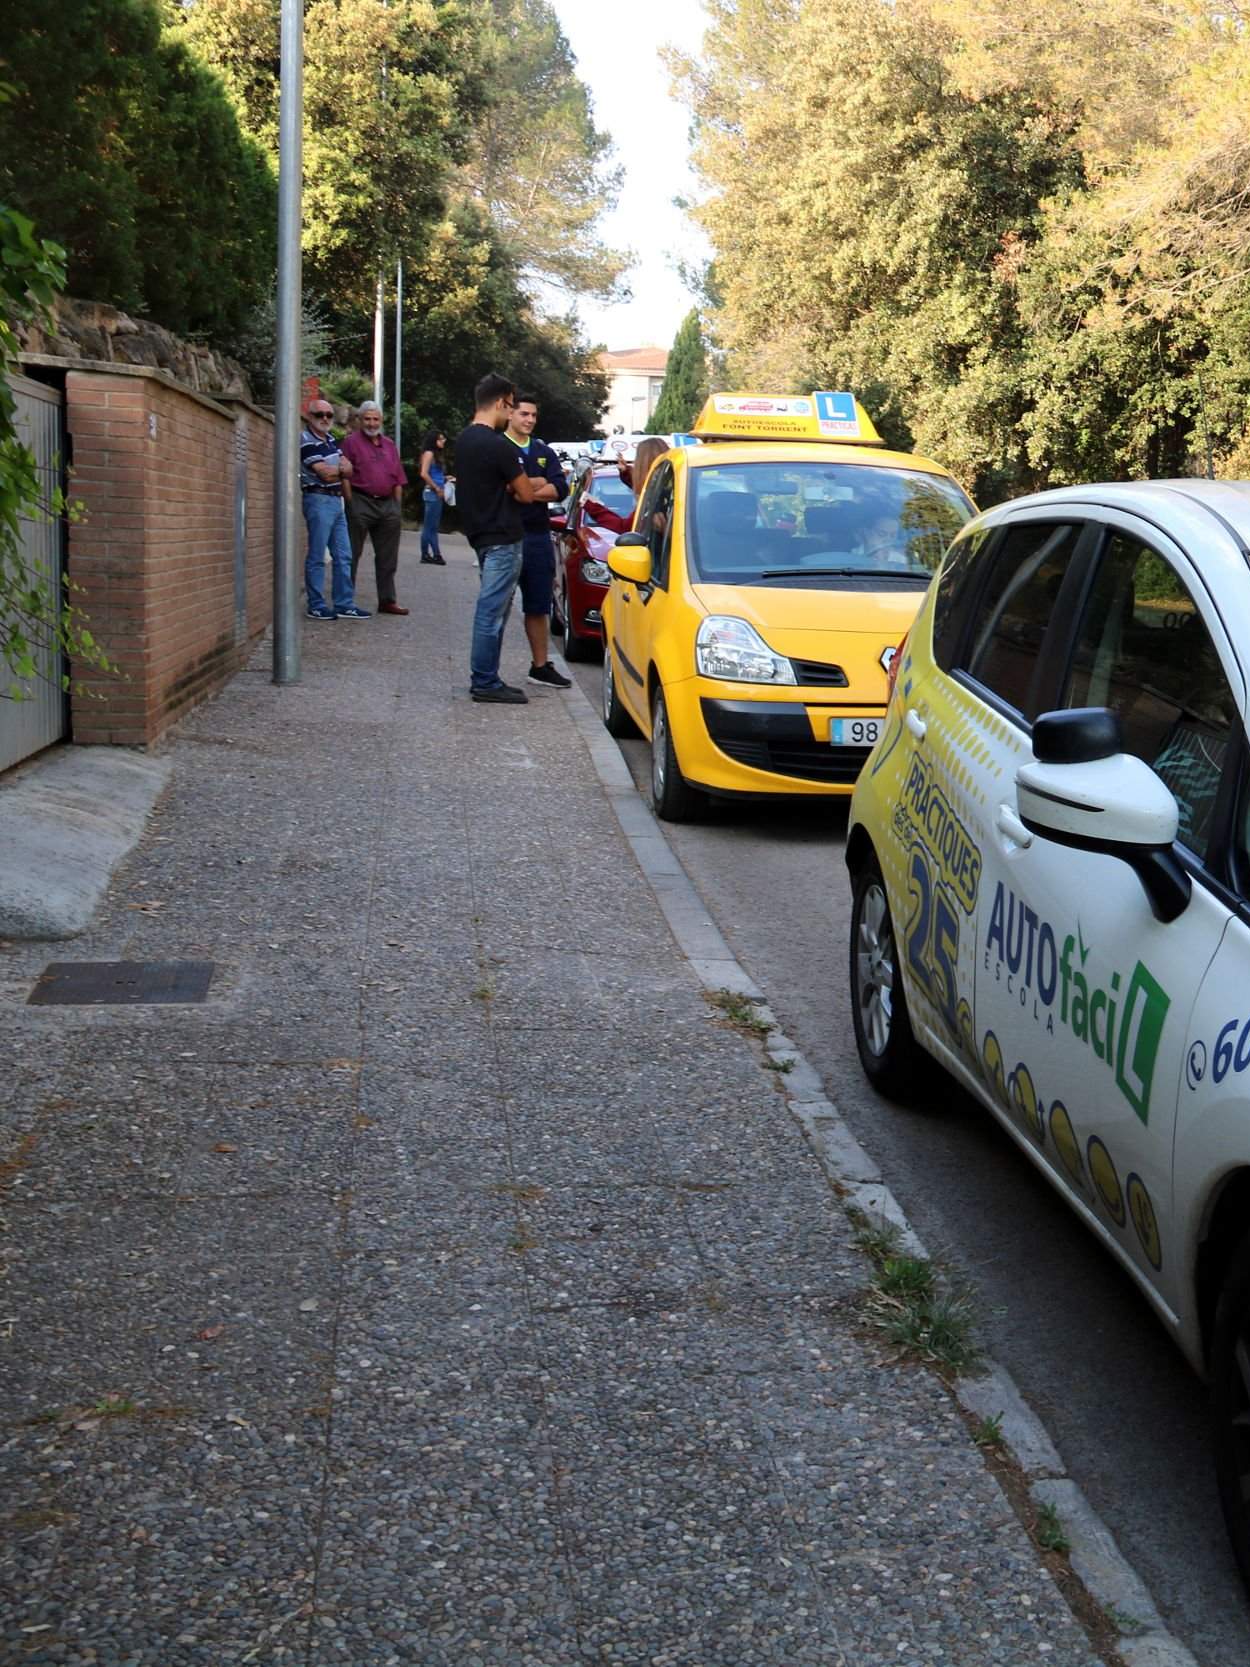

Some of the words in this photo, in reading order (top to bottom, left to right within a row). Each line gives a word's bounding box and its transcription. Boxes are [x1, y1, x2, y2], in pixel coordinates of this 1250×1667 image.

[824, 397, 848, 418] L
[904, 761, 979, 902] PRACTIQUES
[908, 853, 960, 1044] 25
[984, 951, 1054, 1036] ESCOLA
